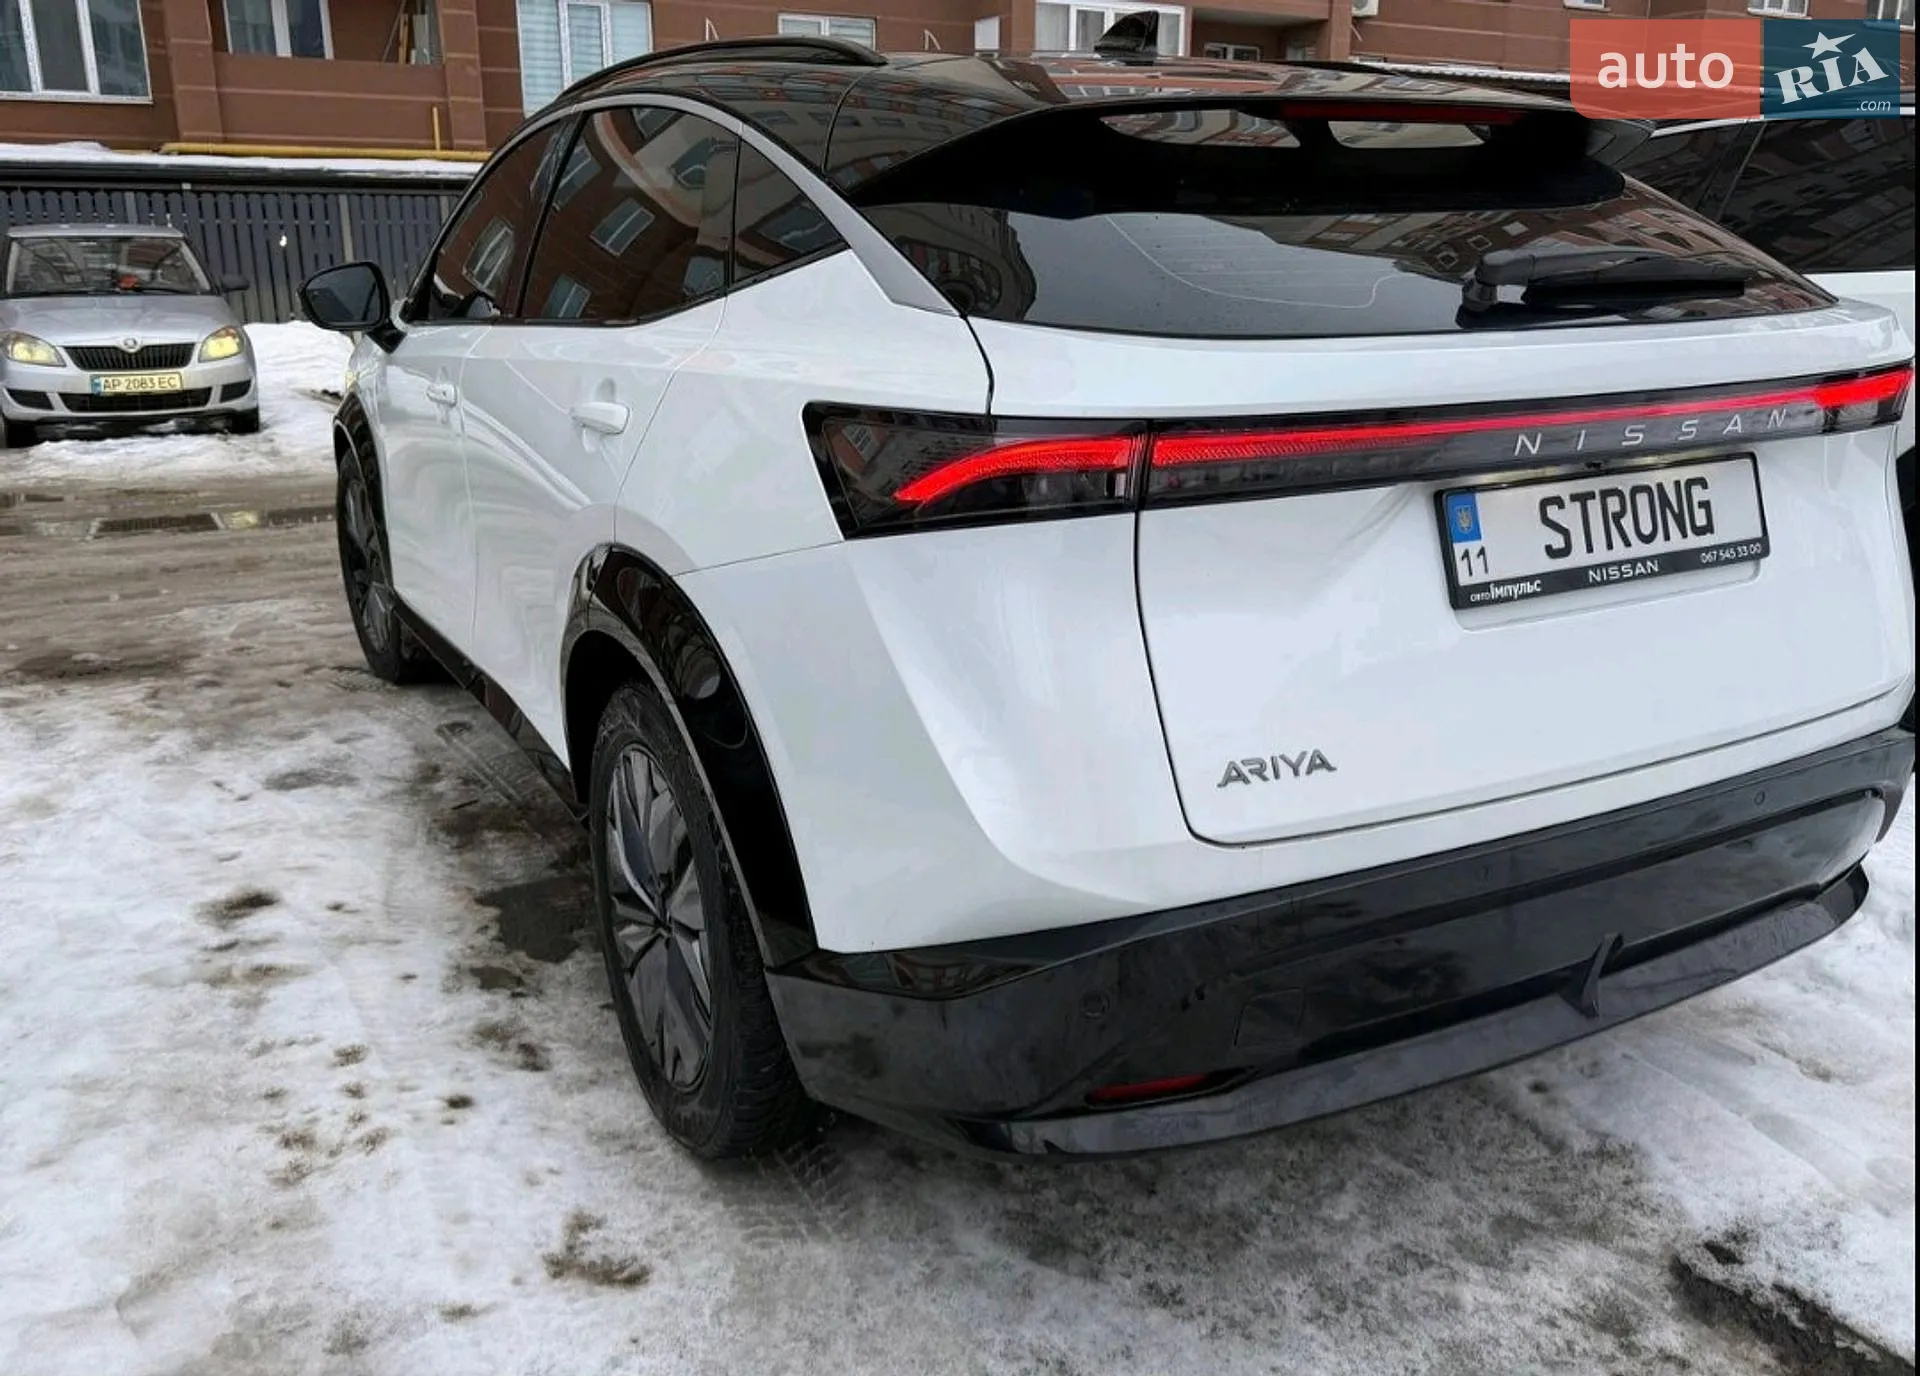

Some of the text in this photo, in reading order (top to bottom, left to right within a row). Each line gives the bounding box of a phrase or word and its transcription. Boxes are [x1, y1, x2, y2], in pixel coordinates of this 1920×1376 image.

[1514, 408, 1787, 456] NISSAN
[1539, 477, 1714, 559] STRONG
[1461, 545, 1489, 577] 11
[1588, 560, 1659, 583] NISSAN
[1217, 749, 1337, 788] ARIYA
